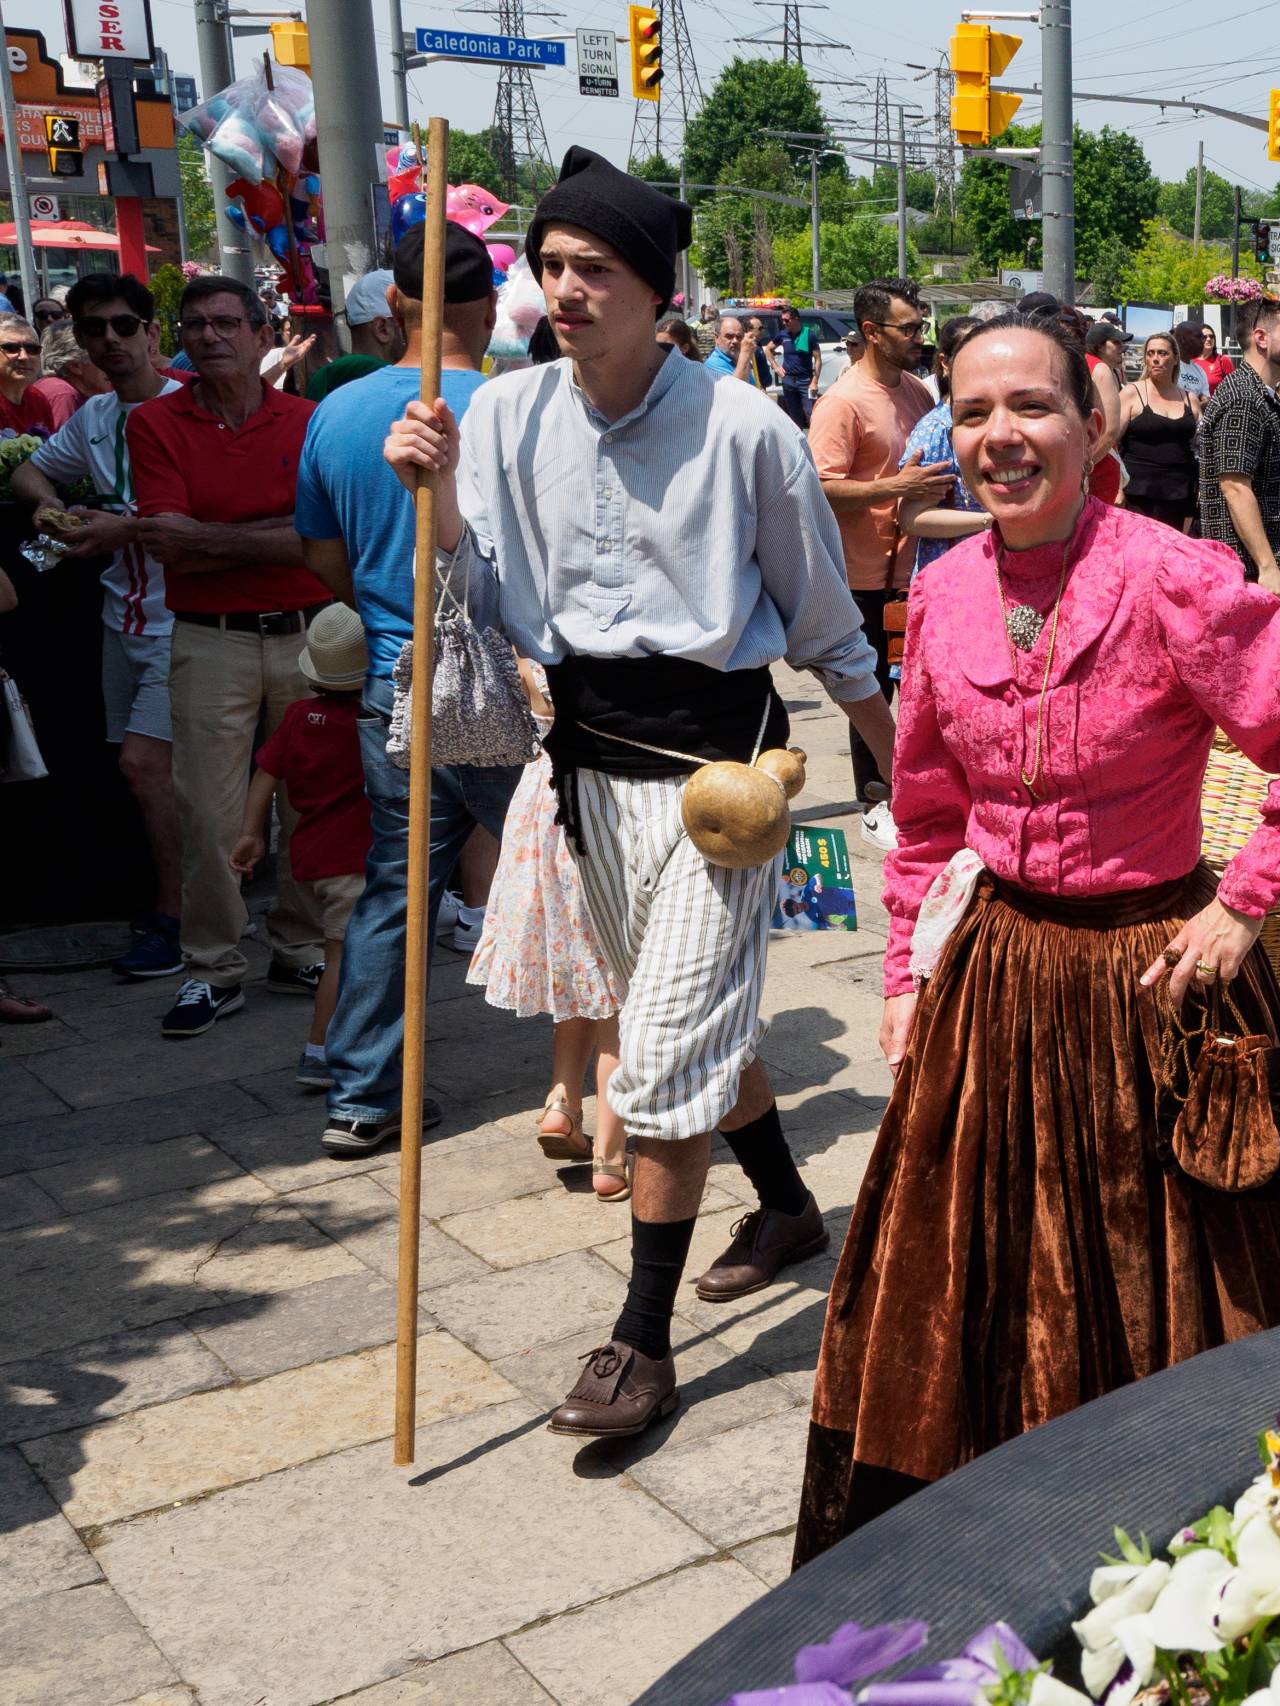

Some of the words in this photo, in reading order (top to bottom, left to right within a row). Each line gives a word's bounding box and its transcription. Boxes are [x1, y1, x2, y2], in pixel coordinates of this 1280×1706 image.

[99, 0, 125, 50] SER
[424, 31, 500, 55] Caledonia
[508, 42, 541, 59] Park
[548, 44, 557, 54] Rd
[583, 34, 608, 46] LEFT
[583, 49, 612, 60] TURN
[582, 63, 615, 76] SIGNAL
[586, 78, 612, 87] U-TURN
[581, 87, 618, 96] PERMITTED
